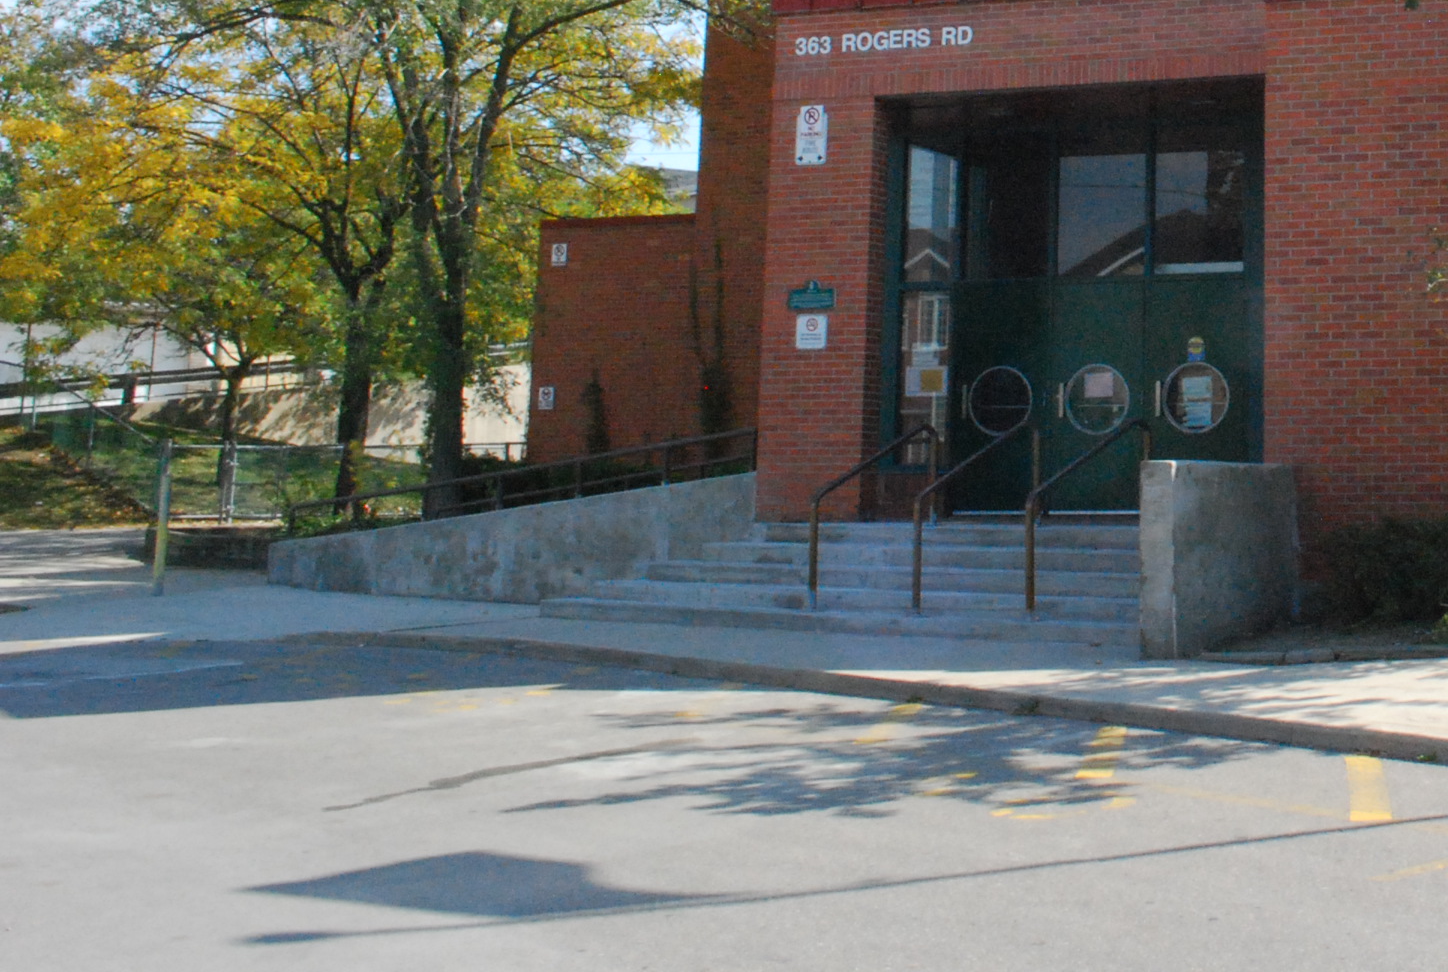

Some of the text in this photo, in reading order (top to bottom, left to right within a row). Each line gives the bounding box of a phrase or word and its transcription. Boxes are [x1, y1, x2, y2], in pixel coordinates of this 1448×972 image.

[795, 26, 973, 55] 363 ROGERS RD
